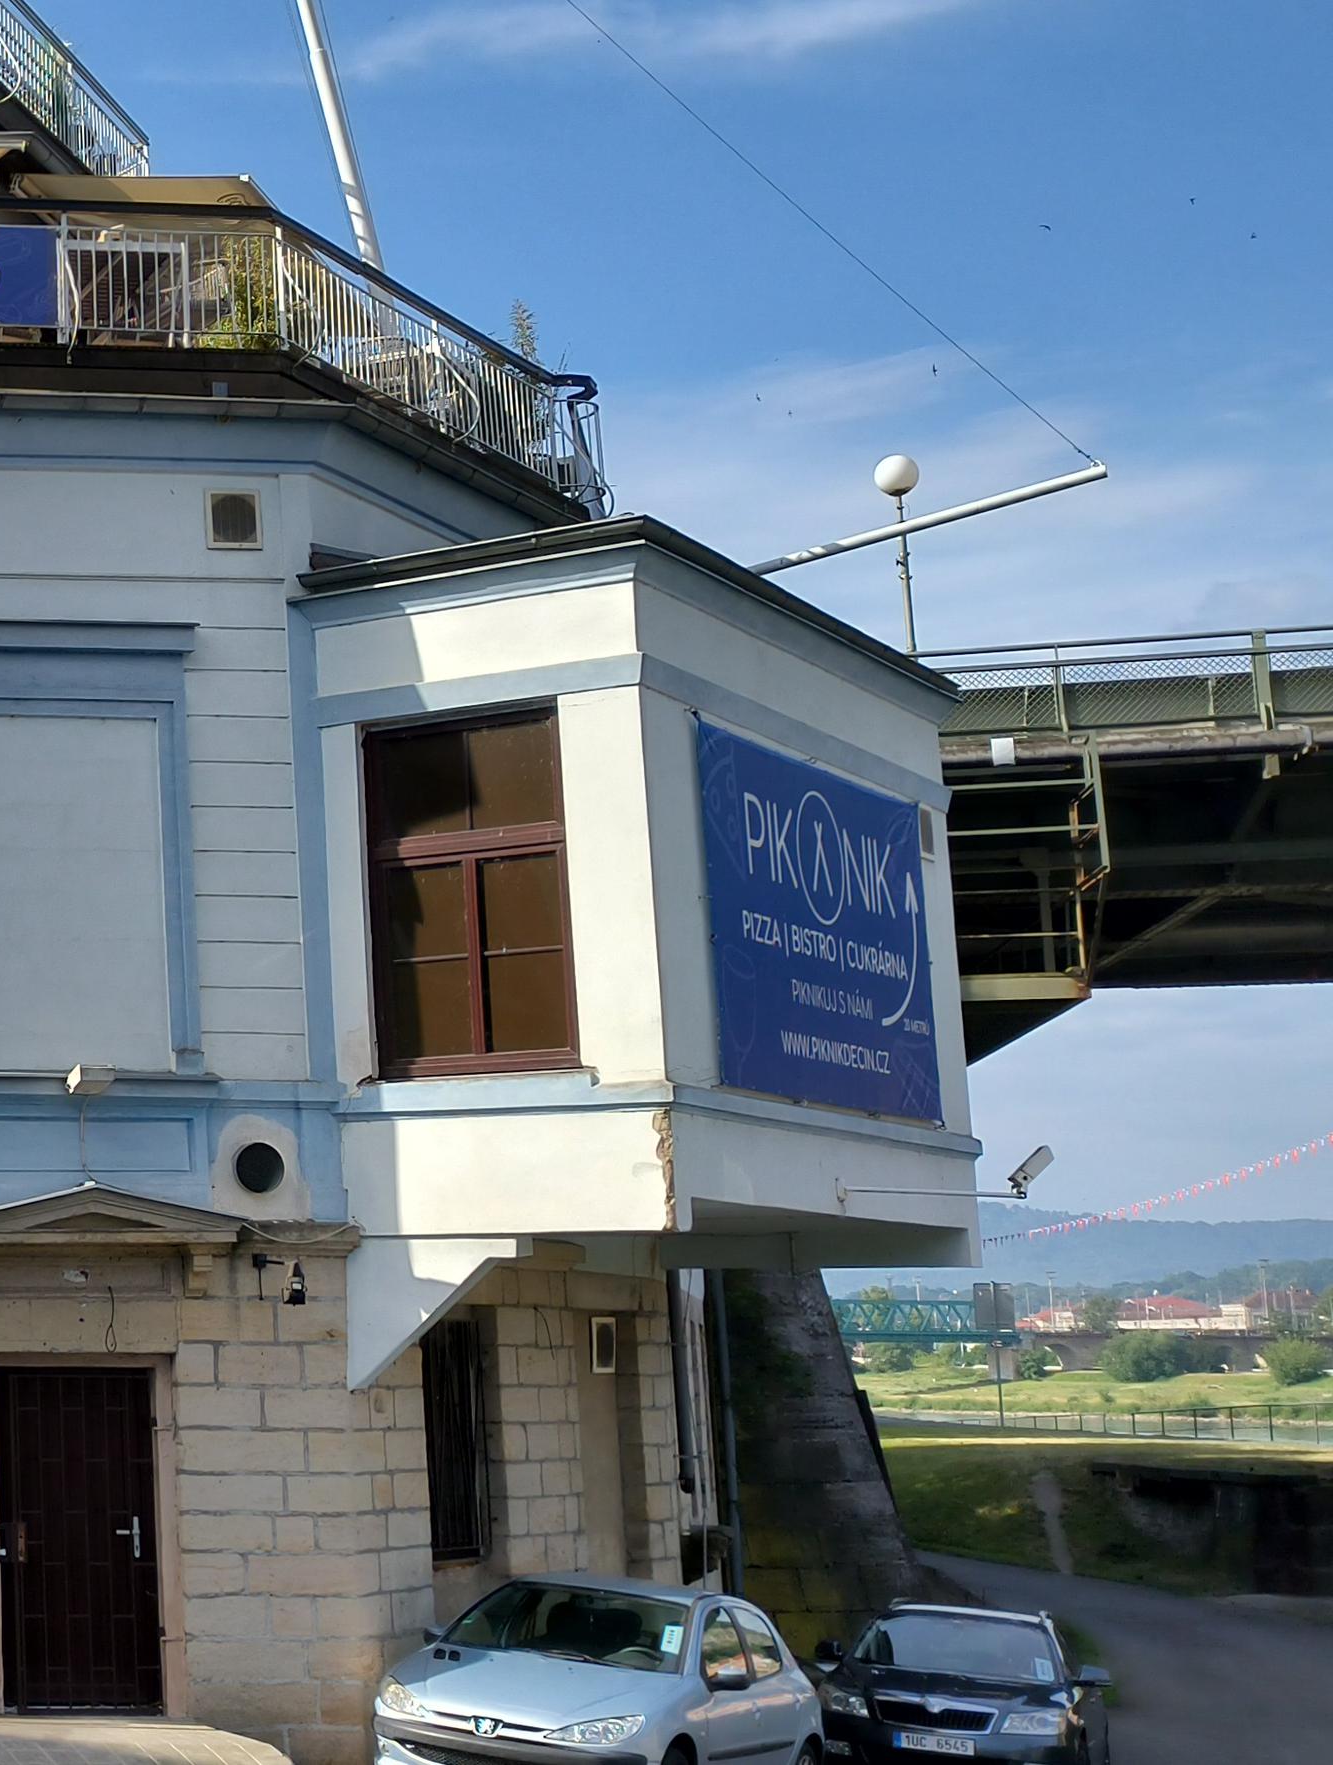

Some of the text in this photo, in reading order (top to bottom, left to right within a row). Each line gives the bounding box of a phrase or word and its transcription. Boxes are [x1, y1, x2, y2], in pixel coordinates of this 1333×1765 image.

[742, 910, 908, 981] PIZZA BISTRO CUKRÁRNA
[791, 979, 873, 1020] PIKNIKUJ S NÁMI
[781, 1030, 891, 1074] WWW.PIKNIKDECIN.CZ
[905, 1735, 968, 1752] 1UC 6545
